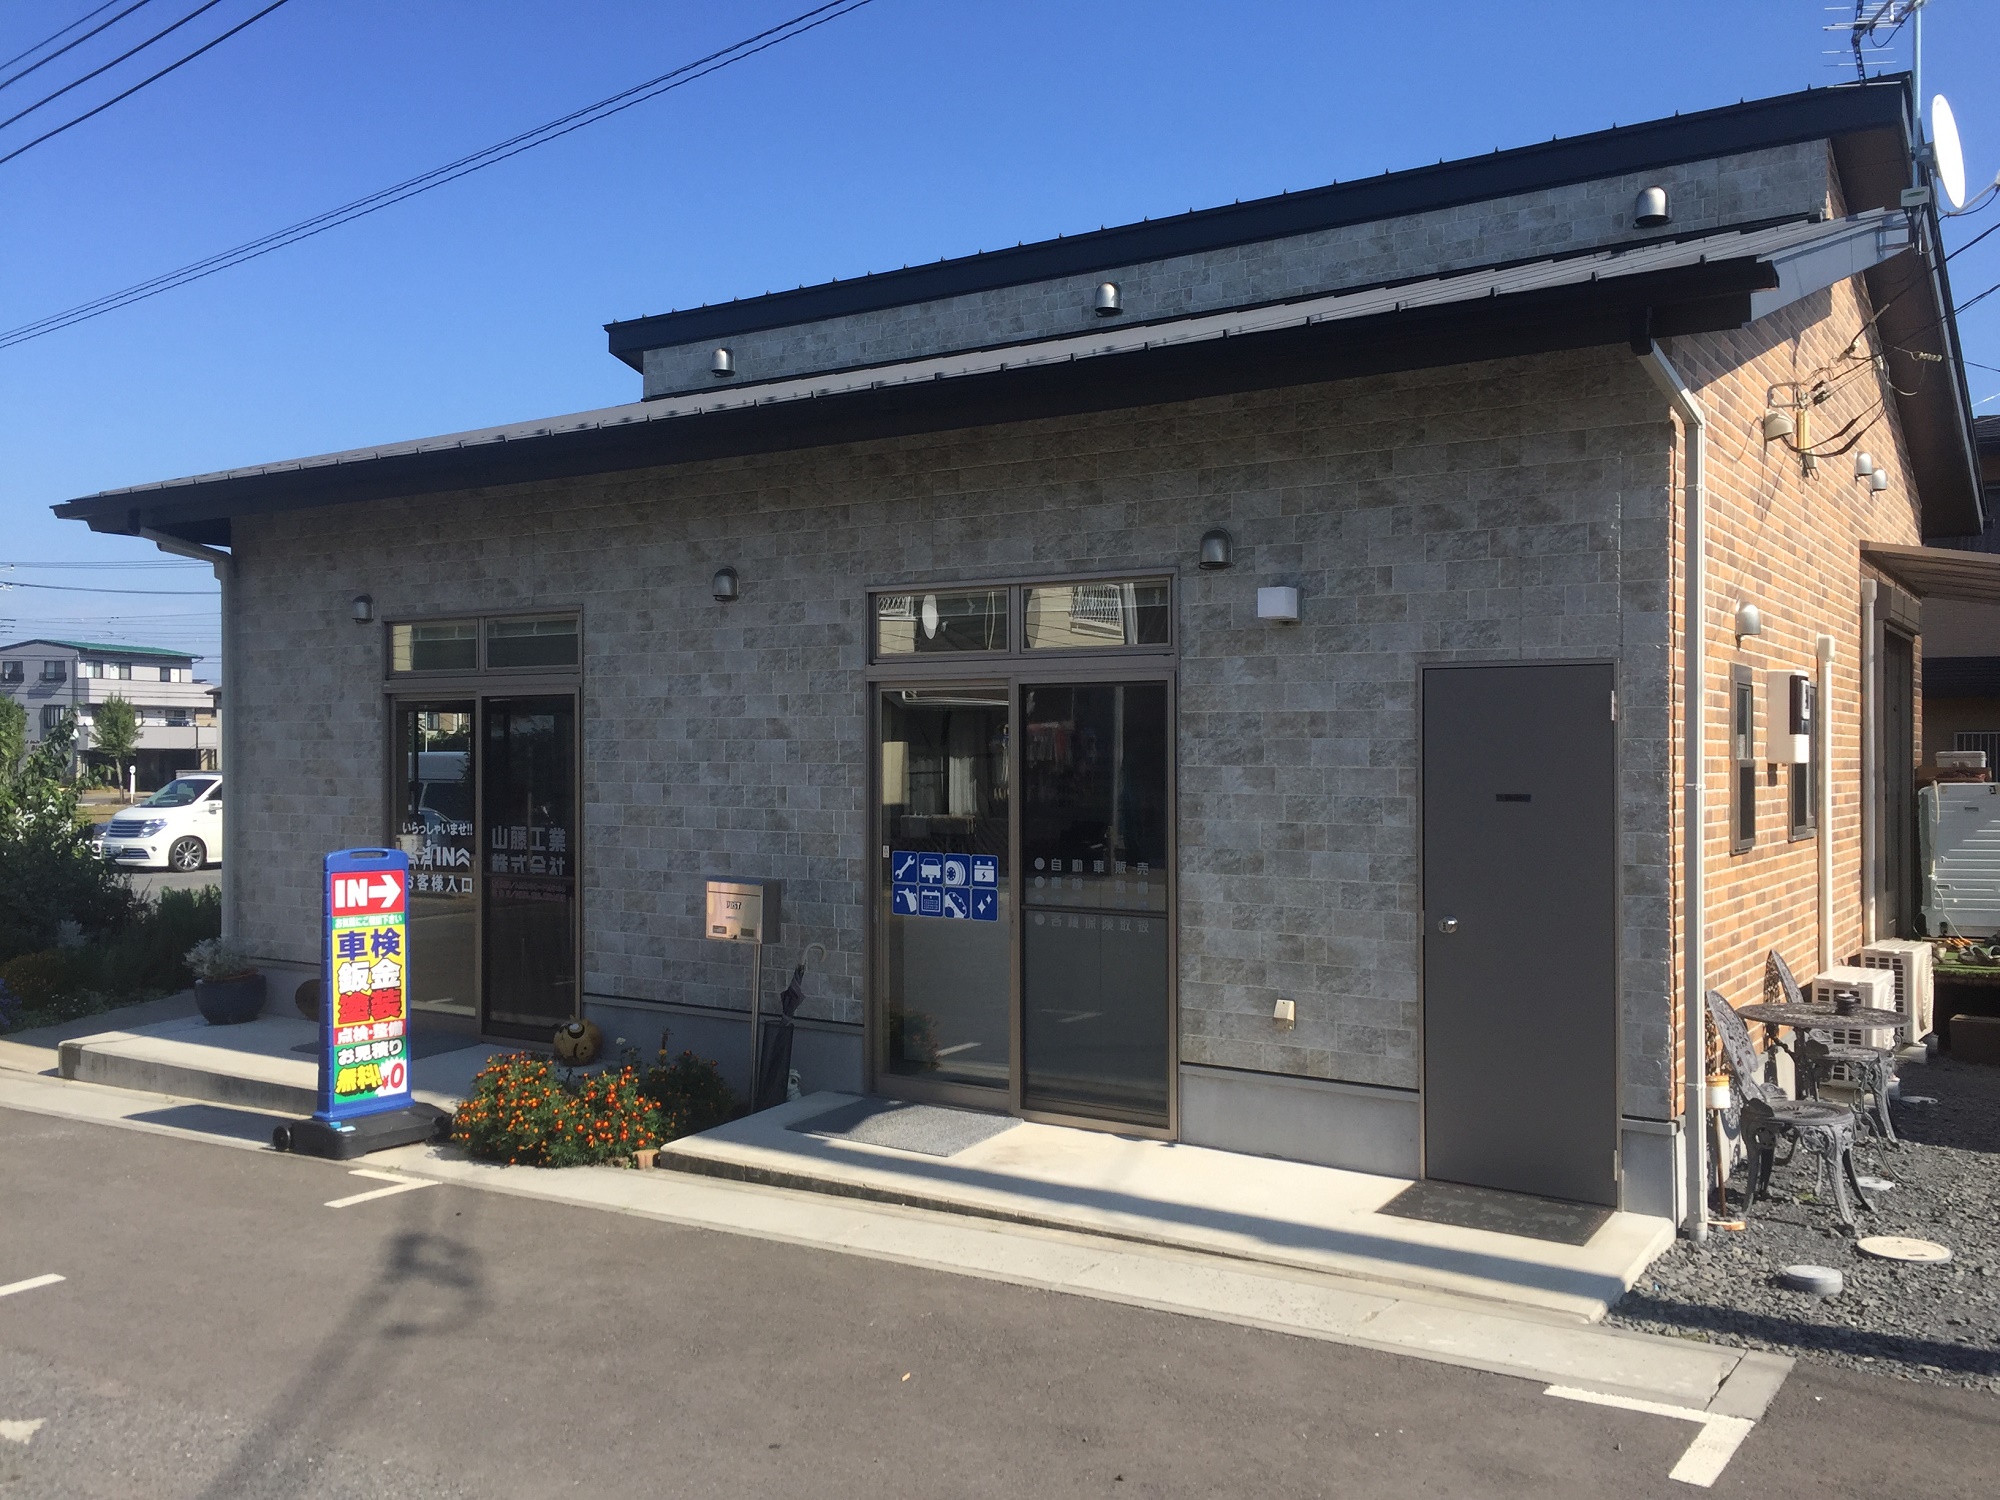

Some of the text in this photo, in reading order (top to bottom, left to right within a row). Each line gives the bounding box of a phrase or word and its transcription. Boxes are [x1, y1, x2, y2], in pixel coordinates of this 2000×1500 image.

[492, 825, 566, 852] 山藤工業
[436, 846, 456, 867] IN
[334, 878, 368, 909] IN
[335, 914, 403, 929] おにご下さい
[336, 927, 402, 961] 車検
[338, 988, 402, 1025] 塗装
[337, 1039, 404, 1067] お見積り
